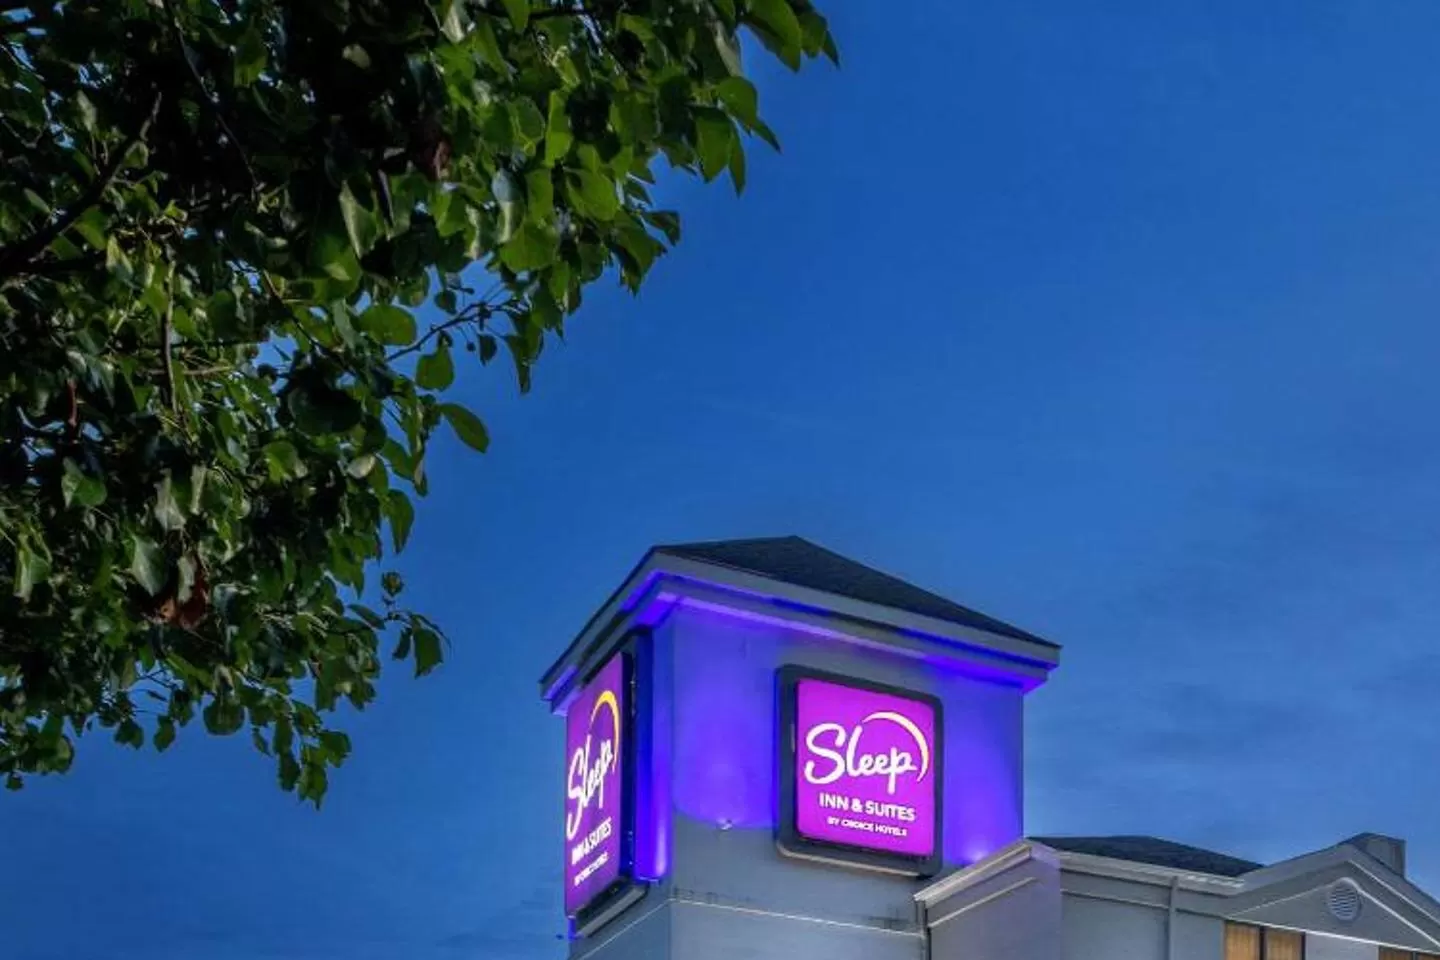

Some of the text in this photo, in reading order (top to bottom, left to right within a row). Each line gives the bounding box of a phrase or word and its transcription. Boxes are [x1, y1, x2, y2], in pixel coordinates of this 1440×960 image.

[567, 734, 613, 840] Sleep
[805, 723, 917, 794] Sleep
[819, 792, 916, 822] INN & SUITES
